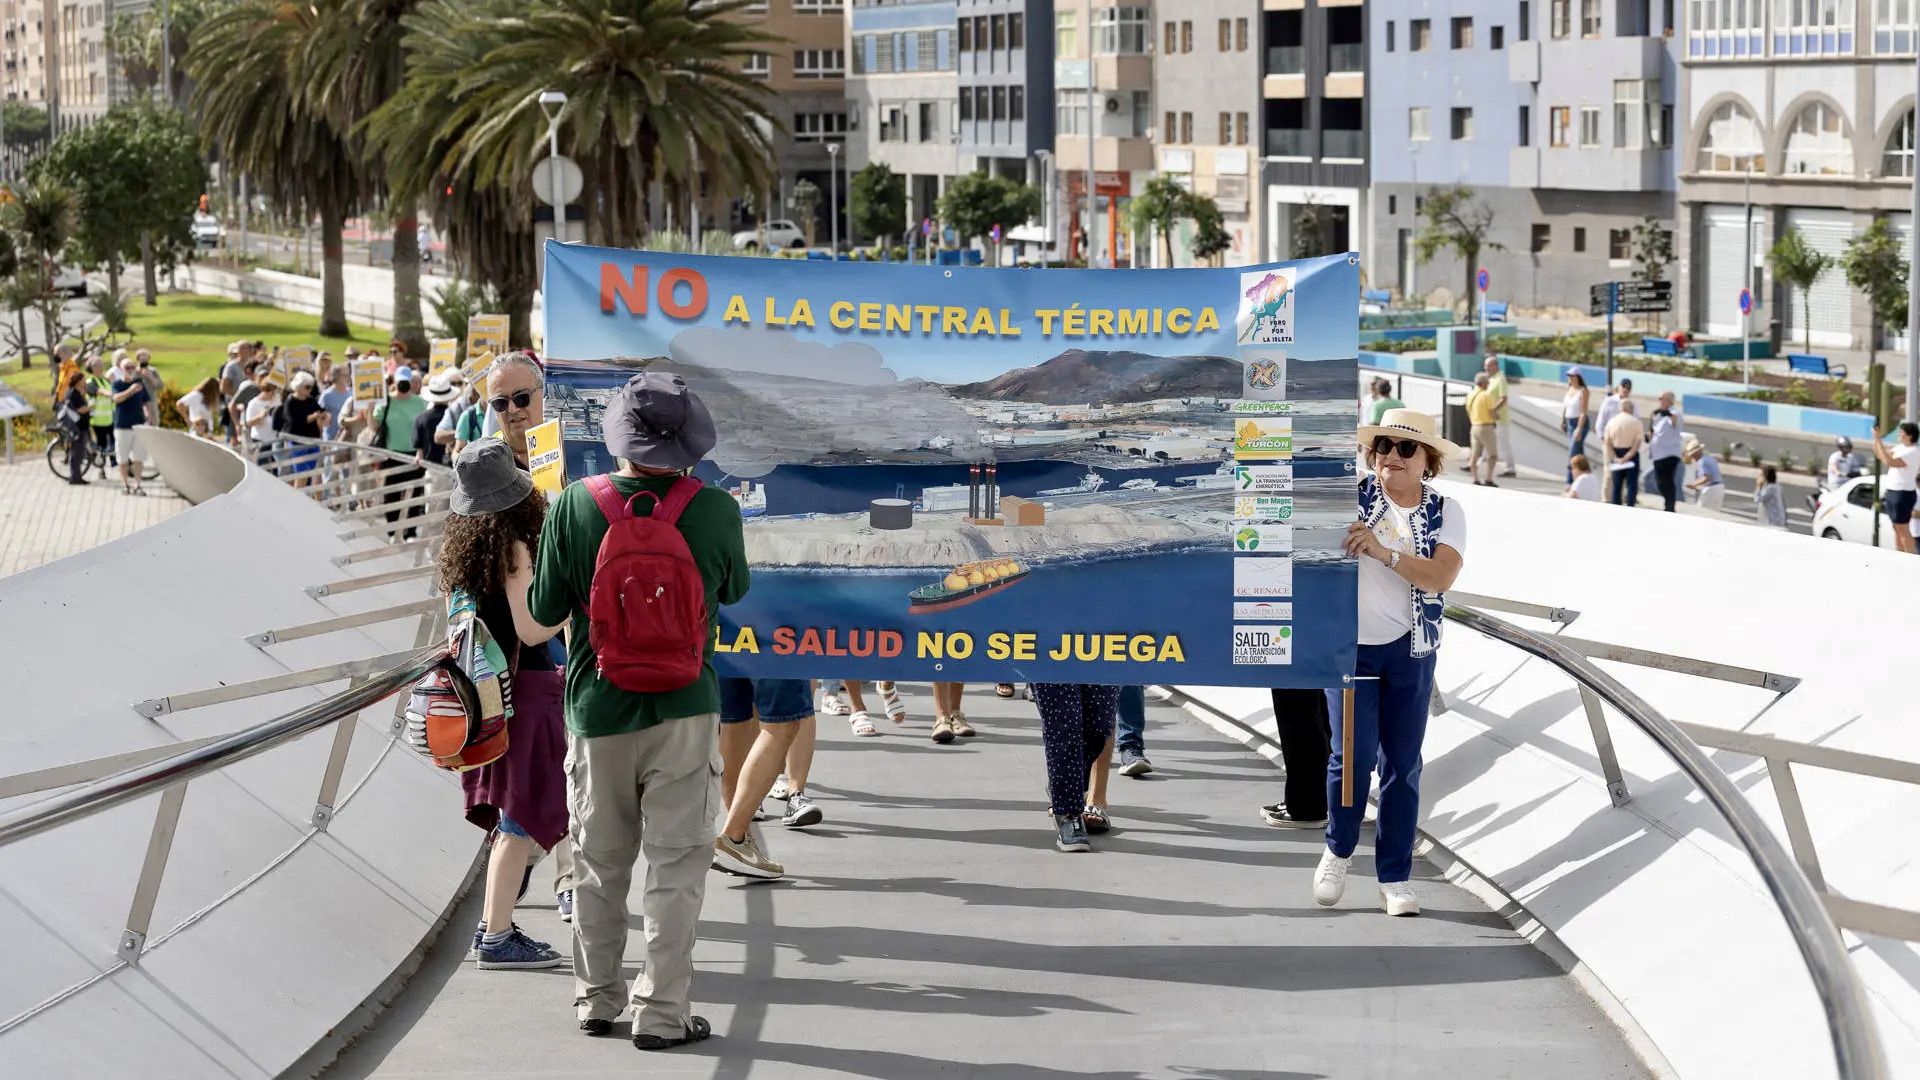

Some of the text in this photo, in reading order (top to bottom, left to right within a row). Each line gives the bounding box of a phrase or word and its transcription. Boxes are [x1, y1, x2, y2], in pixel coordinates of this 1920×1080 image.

[600, 262, 1220, 336] NO A LA CENTRAL TÉRMICA
[1235, 402, 1292, 411] GREENPEACE
[527, 435, 537, 449] NO
[714, 627, 1185, 662] LA SALUD NO SE JUEGA
[1235, 632, 1270, 647] SALTO
[1234, 646, 1286, 656] A LA TRANSICIÓN
[1234, 655, 1267, 664] ECOLÓGICA
